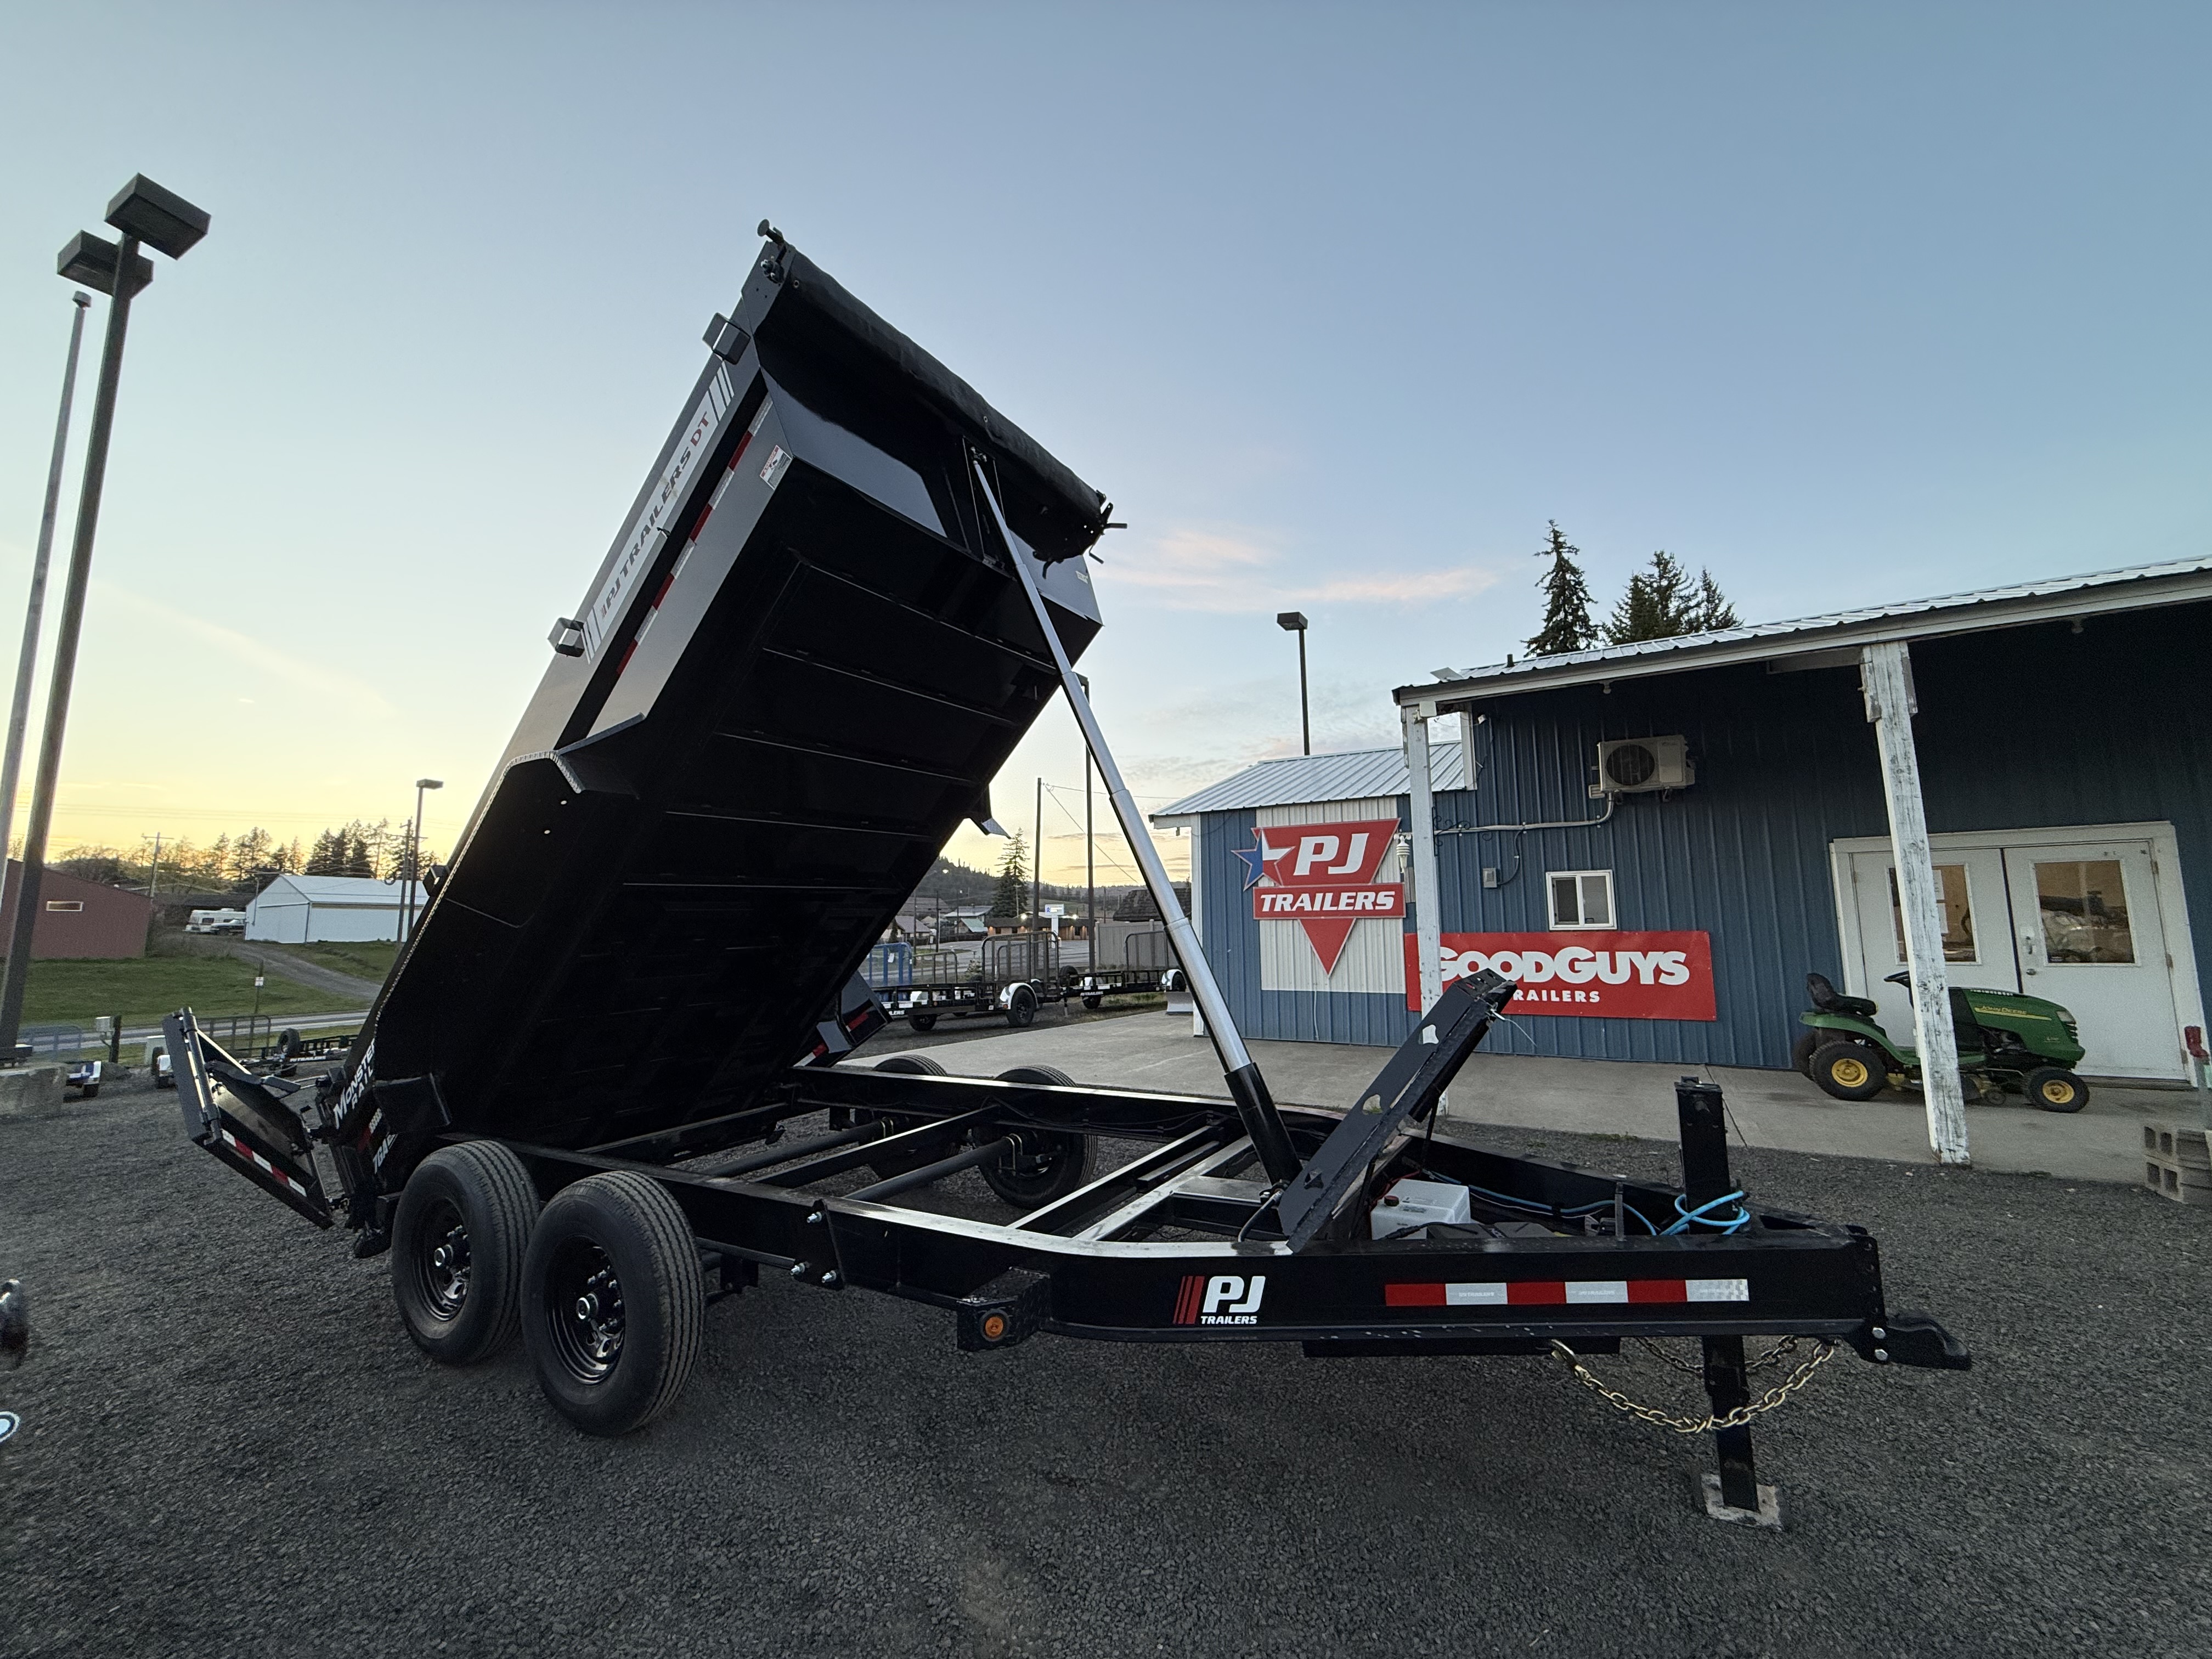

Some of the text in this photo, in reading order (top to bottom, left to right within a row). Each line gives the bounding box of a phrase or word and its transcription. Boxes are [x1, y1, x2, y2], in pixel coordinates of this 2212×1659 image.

[606, 579, 620, 610] PJ
[619, 447, 691, 578] TRAILERS
[690, 411, 709, 447] DT
[1294, 833, 1369, 875] PJ
[1260, 891, 1395, 912] TRAILERS
[1513, 990, 1600, 1003] RAILERS
[351, 1065, 374, 1110] RAIL
[1203, 1276, 1266, 1313] PJ
[1200, 1316, 1257, 1324] TRAILERS
